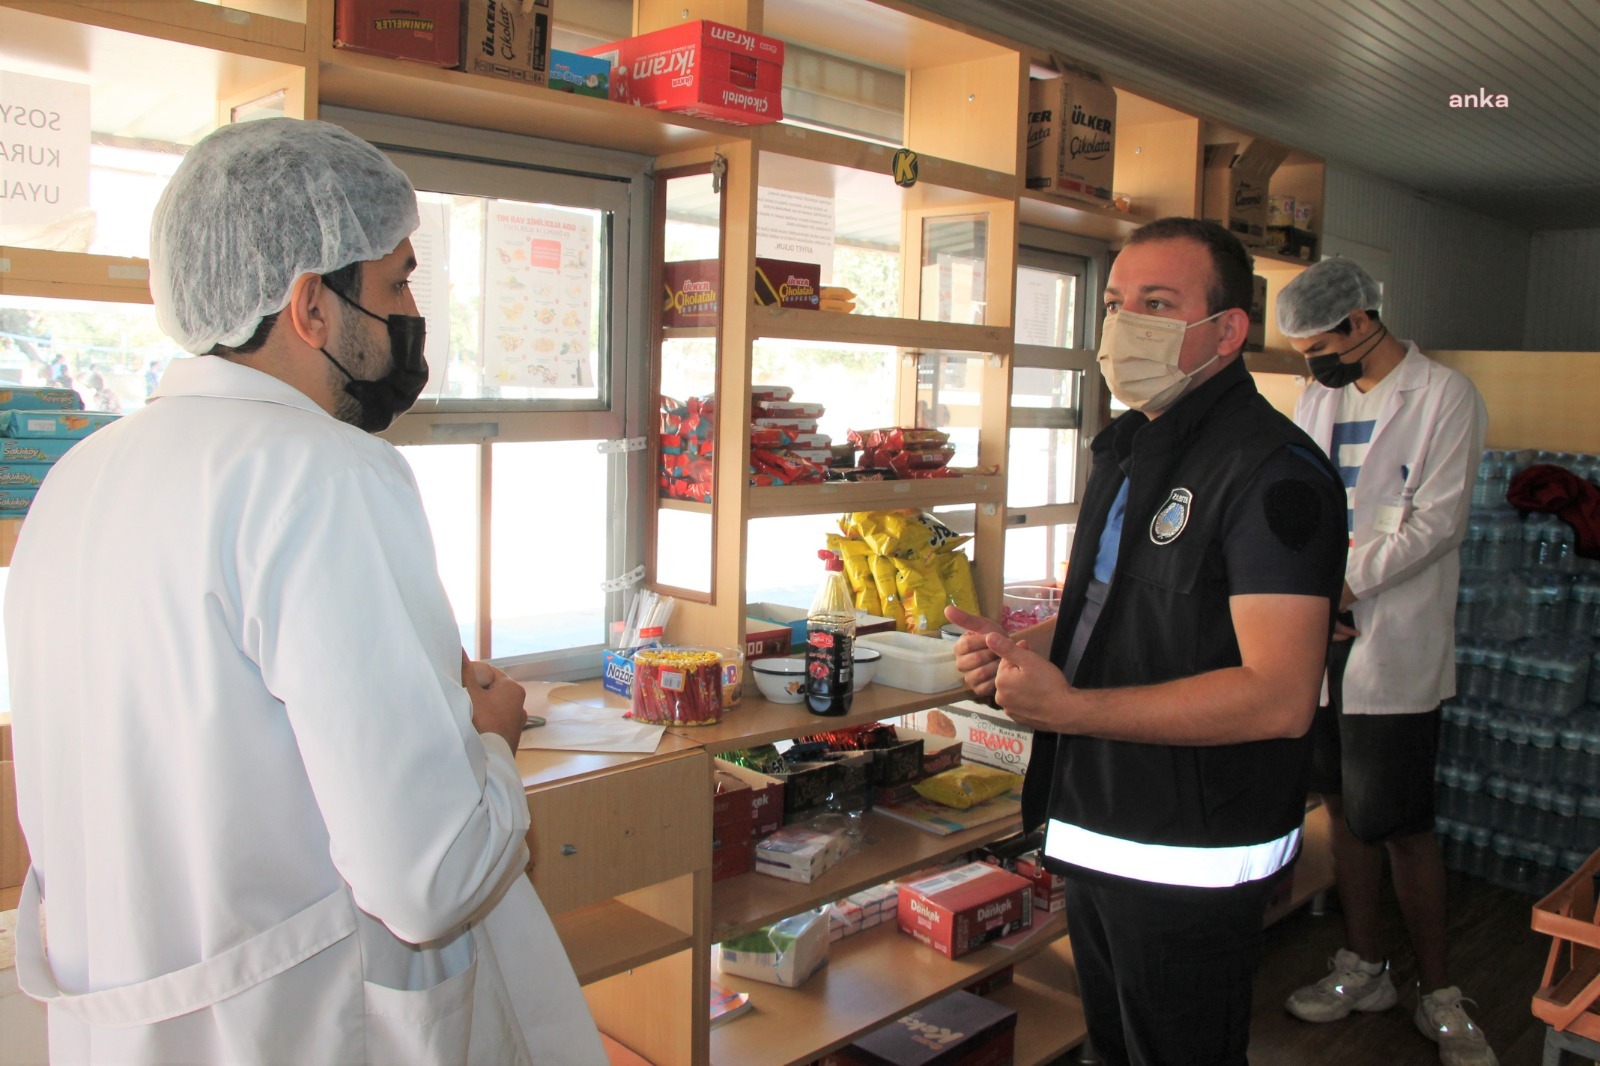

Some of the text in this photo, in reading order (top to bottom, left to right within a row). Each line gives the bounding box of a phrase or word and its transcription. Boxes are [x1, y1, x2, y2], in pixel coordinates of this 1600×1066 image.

[375, 19, 434, 32] HANIMELLER
[496, 3, 516, 61] Çikolat
[711, 26, 756, 52] ikram
[632, 49, 696, 80] ikram
[671, 75, 694, 89] ÜLKER
[721, 90, 769, 113] Çikolatalı
[1071, 105, 1112, 135] ÜLKER
[1070, 132, 1111, 160] Çikolata
[895, 151, 916, 183] K
[682, 279, 711, 293] ÜLKER
[786, 275, 810, 287] ÜLKER
[674, 289, 717, 314] Çikolatalı
[605, 660, 634, 685] Nazar
[969, 728, 1024, 755] BRAWO
